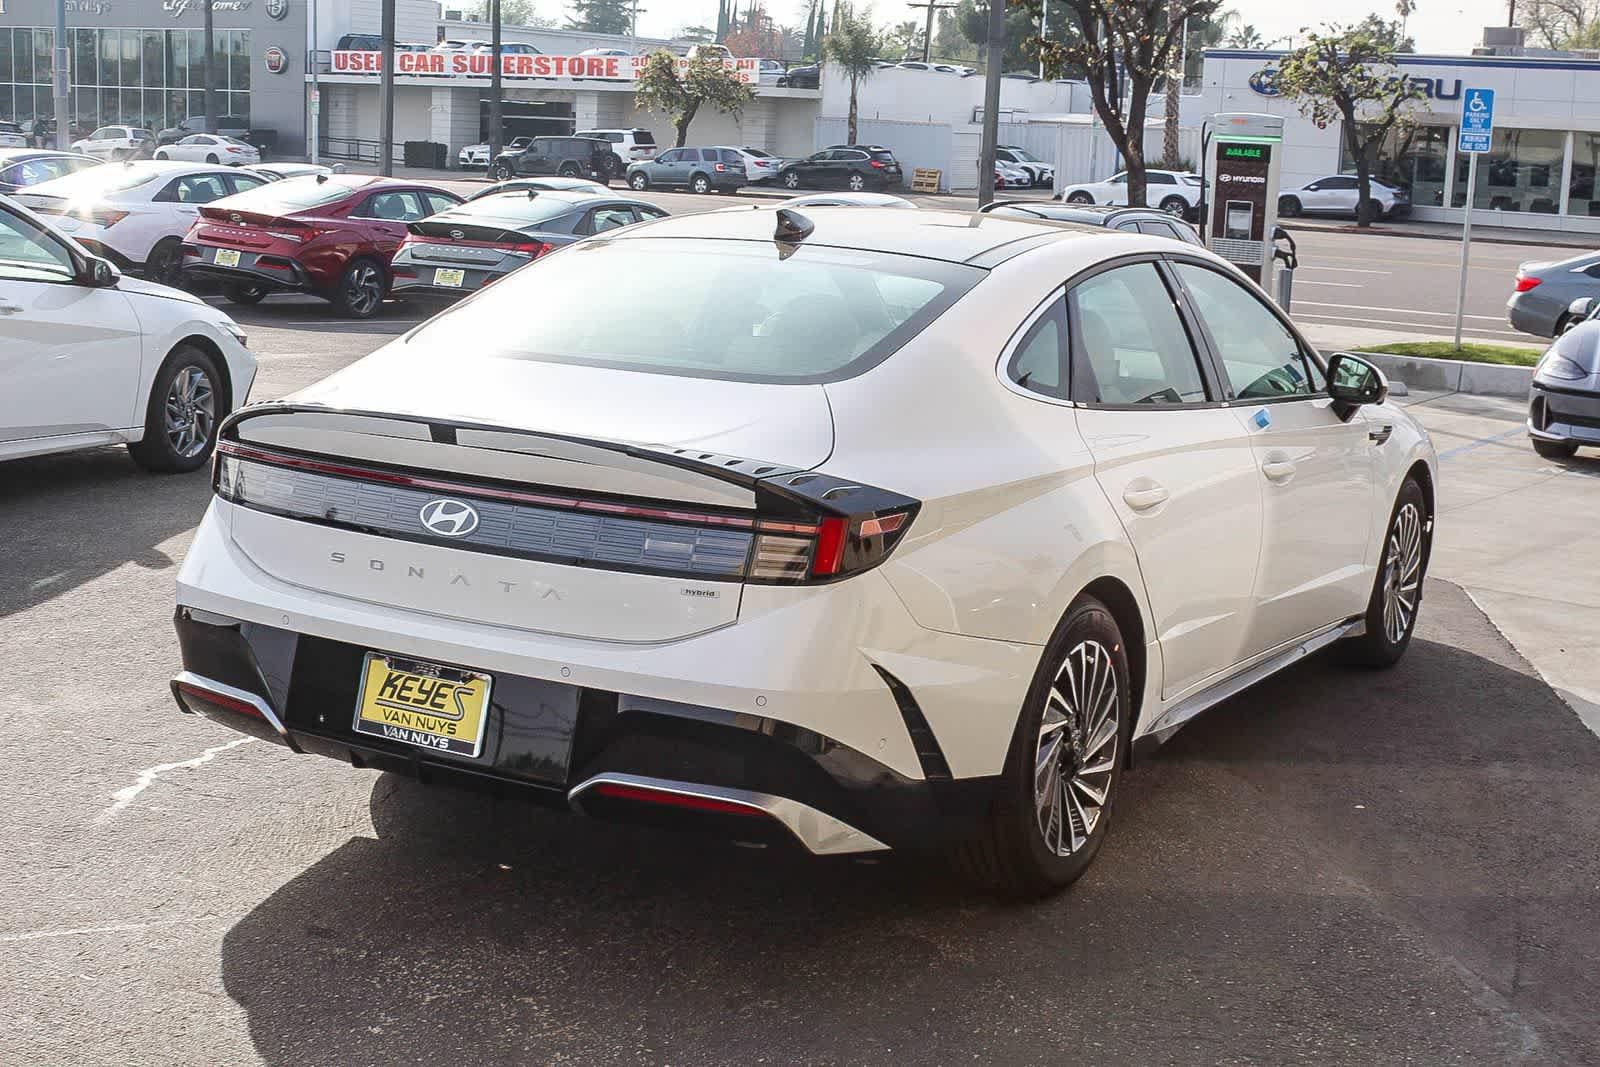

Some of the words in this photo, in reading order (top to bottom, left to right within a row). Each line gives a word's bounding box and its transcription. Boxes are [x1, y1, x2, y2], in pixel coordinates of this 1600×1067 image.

[400, 53, 444, 72] CAR
[330, 551, 565, 600] SONATA
[685, 588, 715, 597] hybrid
[375, 671, 475, 721] KEYES
[383, 709, 411, 726] VAN
[416, 714, 457, 735] NUYS
[383, 725, 409, 741] VAN
[411, 732, 449, 749] NUYS
